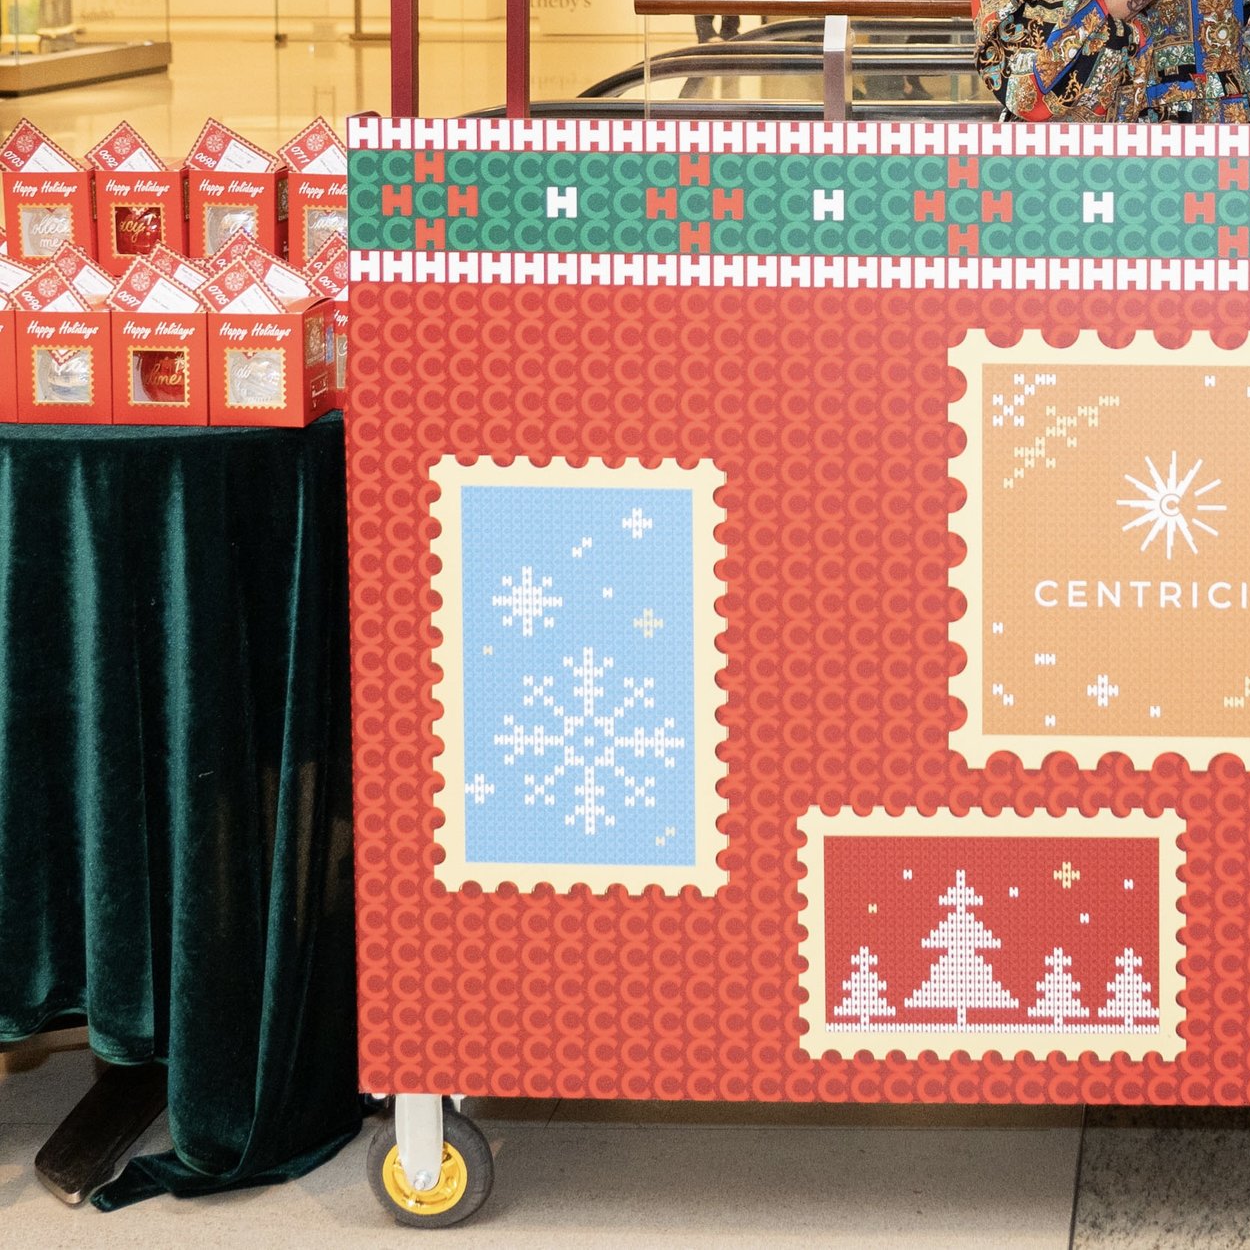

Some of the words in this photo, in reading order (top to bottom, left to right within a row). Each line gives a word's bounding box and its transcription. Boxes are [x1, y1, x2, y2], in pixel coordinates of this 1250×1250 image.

[3, 150, 25, 168] 0703
[99, 149, 119, 168] 0692
[194, 152, 217, 168] 0698
[290, 146, 311, 165] 0711
[12, 180, 38, 197] Happy
[41, 180, 78, 197] Holidays
[105, 179, 131, 196] Happy
[133, 179, 170, 197] Holidays
[199, 179, 225, 196] Happy
[228, 180, 265, 198] Holidays
[298, 181, 325, 199] Happy
[319, 275, 342, 294] 0674
[21, 291, 42, 310] 0696
[117, 291, 142, 308] 0697
[208, 285, 231, 306] 0705
[27, 320, 56, 339] Happy
[59, 320, 99, 340] Holidays
[123, 321, 151, 340] Happy
[155, 321, 196, 341] Holidays
[219, 322, 248, 341] Happy
[251, 323, 292, 342] Holidays
